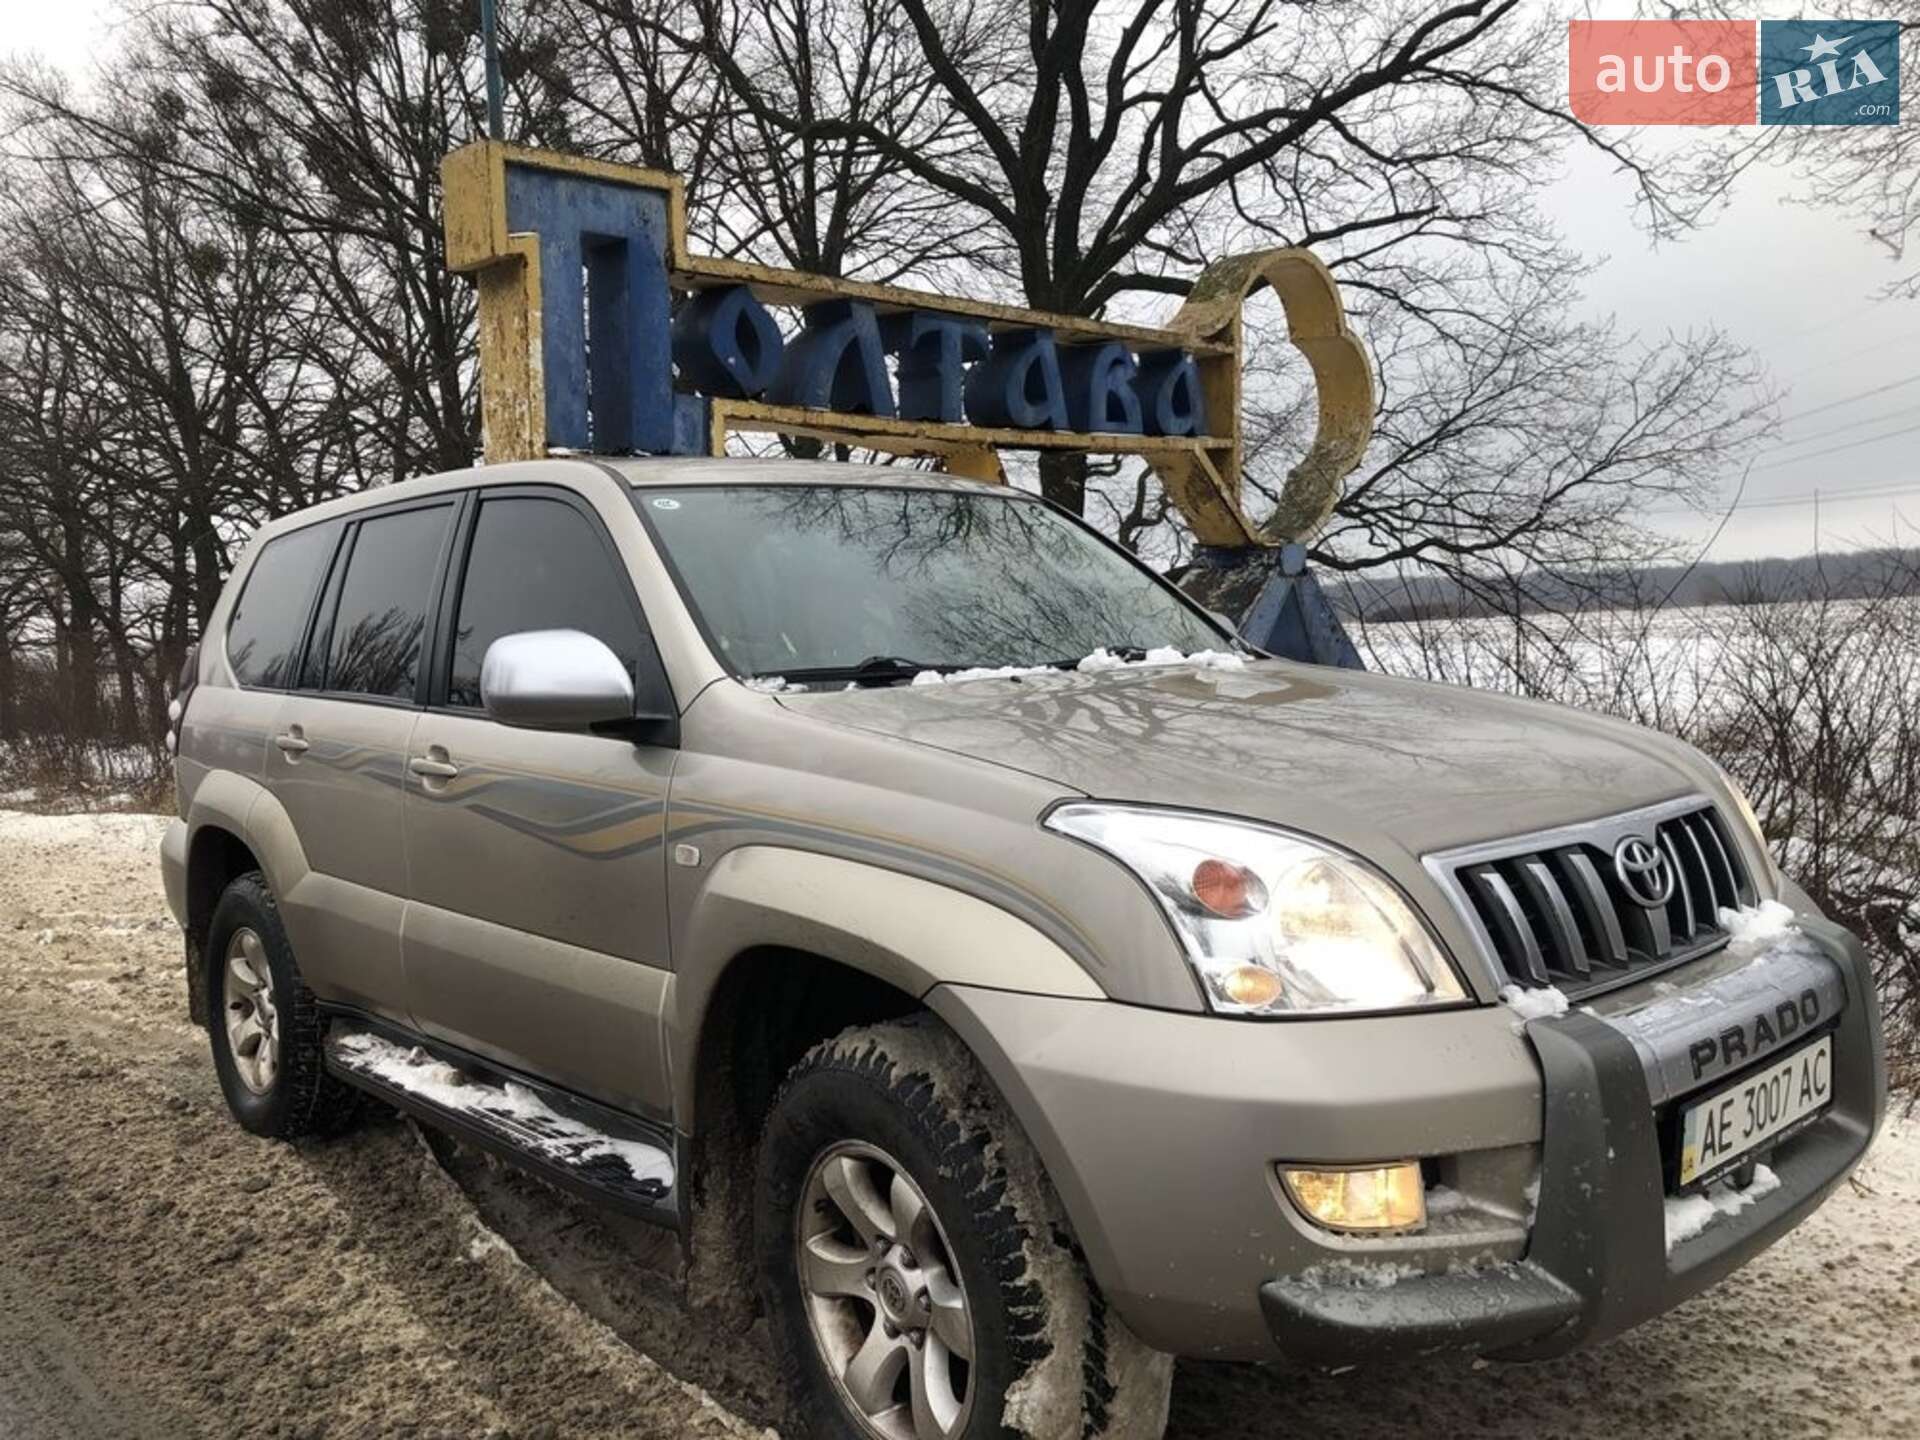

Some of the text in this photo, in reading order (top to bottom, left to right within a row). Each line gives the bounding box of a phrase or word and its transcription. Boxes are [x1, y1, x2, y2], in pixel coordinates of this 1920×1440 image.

[506, 160, 1208, 455] Полтава
[1689, 988, 1820, 1080] PRADO
[1701, 1098, 1734, 1165] AE
[1743, 1066, 1792, 1138] 3007
[1799, 1049, 1826, 1107] AC
